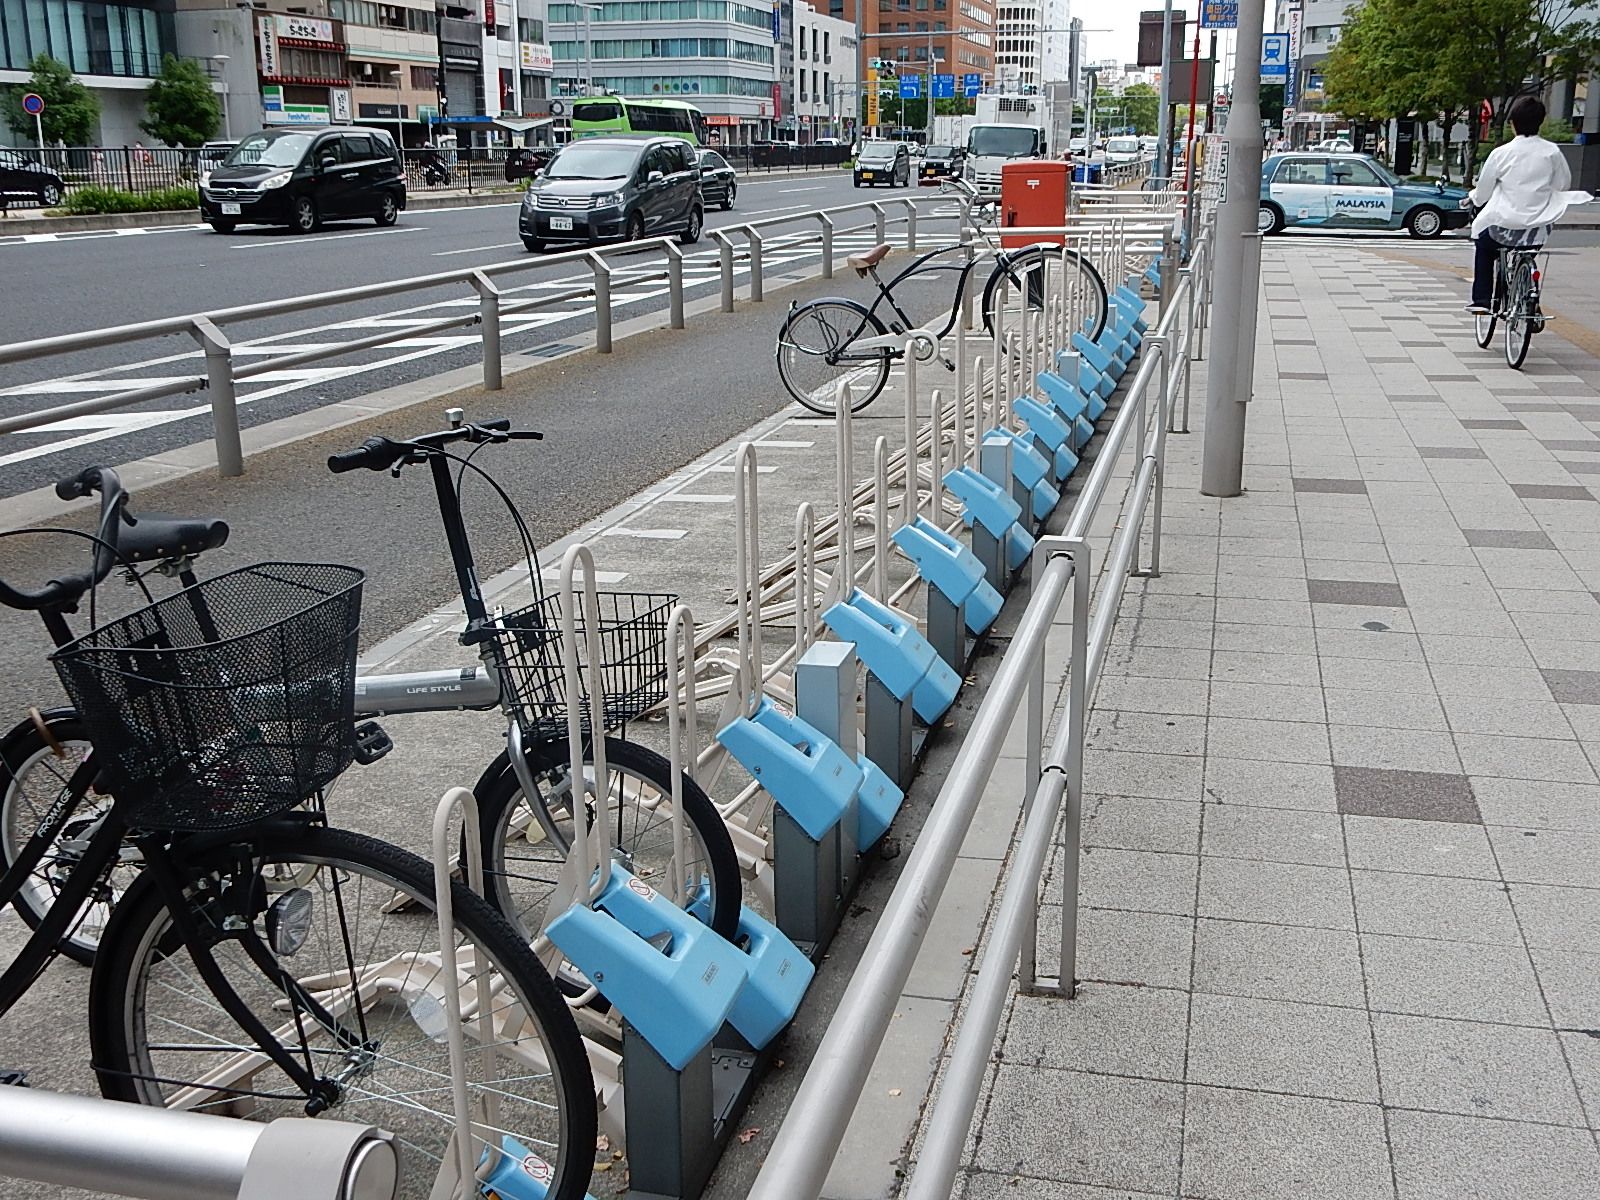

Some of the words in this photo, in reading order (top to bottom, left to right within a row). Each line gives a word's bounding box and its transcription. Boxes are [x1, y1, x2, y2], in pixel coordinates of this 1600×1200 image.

[1335, 200, 1386, 209] MALAYSIA
[430, 685, 462, 693] STYLE
[36, 788, 73, 838] FROMAGE
